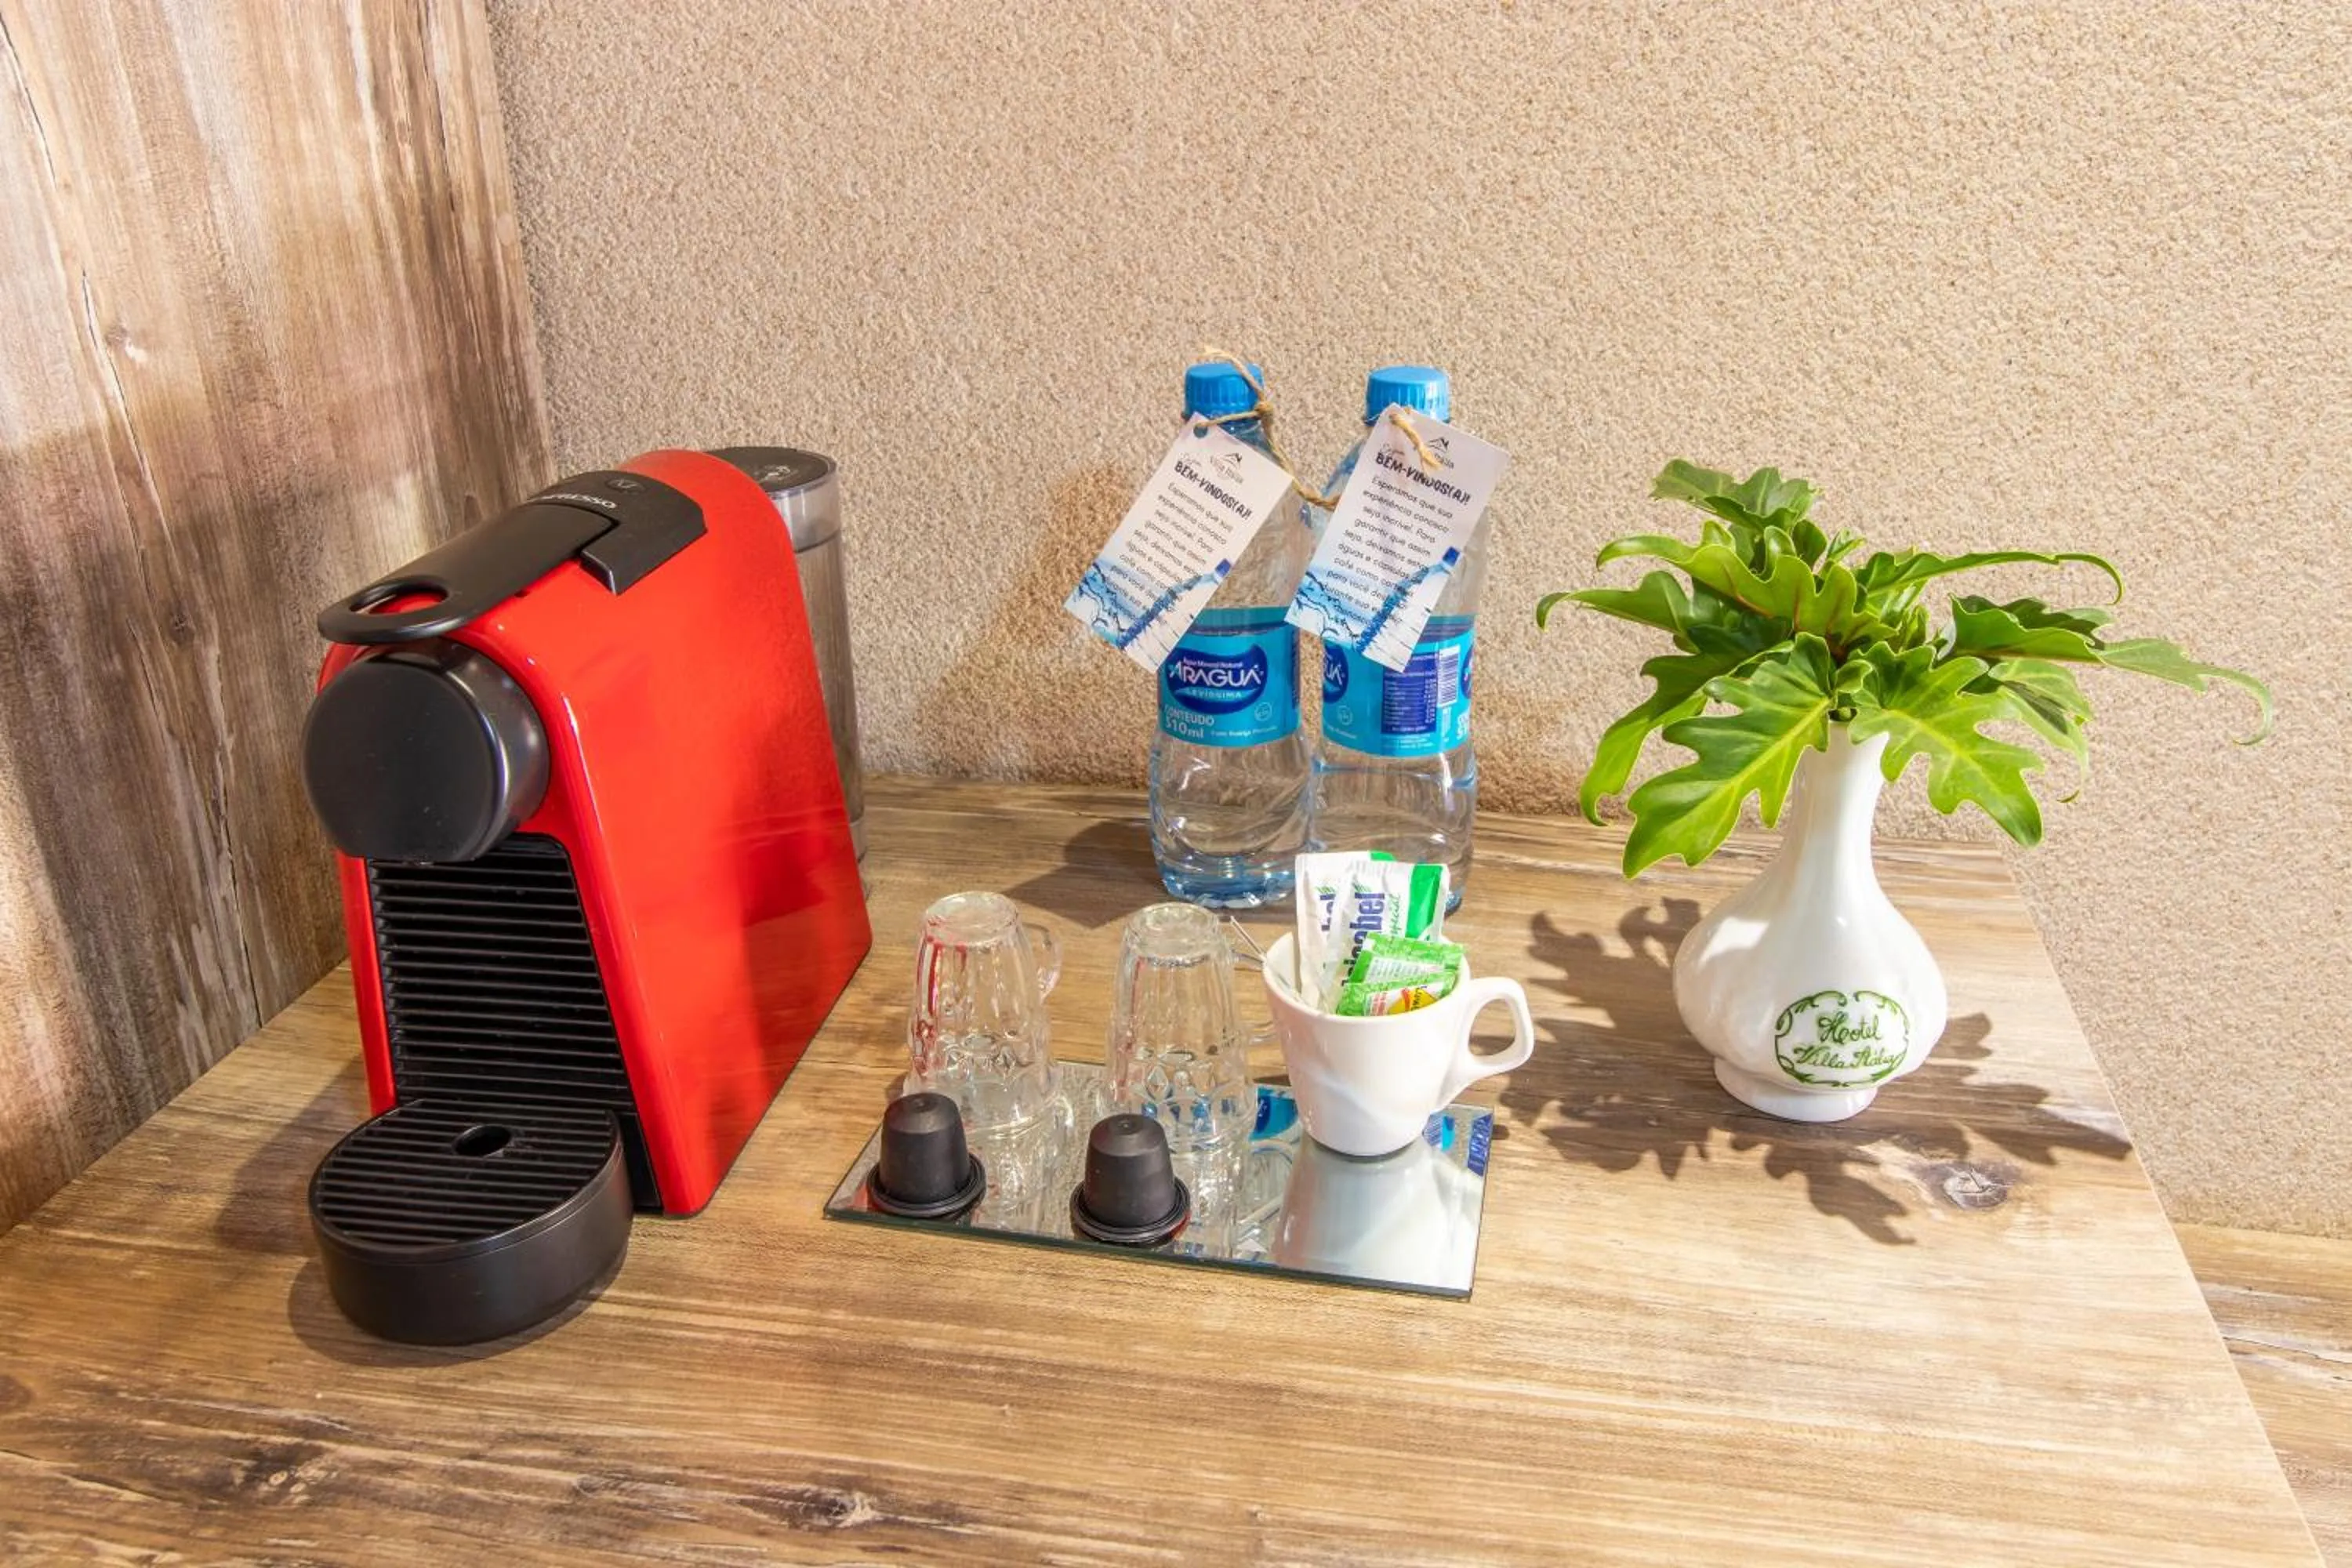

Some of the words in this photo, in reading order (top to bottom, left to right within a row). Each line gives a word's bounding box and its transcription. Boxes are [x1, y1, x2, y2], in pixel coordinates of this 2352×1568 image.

[1370, 475, 1419, 503] Esperamos
[1417, 499, 1436, 511] que
[1374, 454, 1471, 503] BEM-VINDOS(A)!
[1388, 534, 1406, 546] que
[1415, 528, 1437, 543] Para
[1817, 1011, 1882, 1044] Hotel
